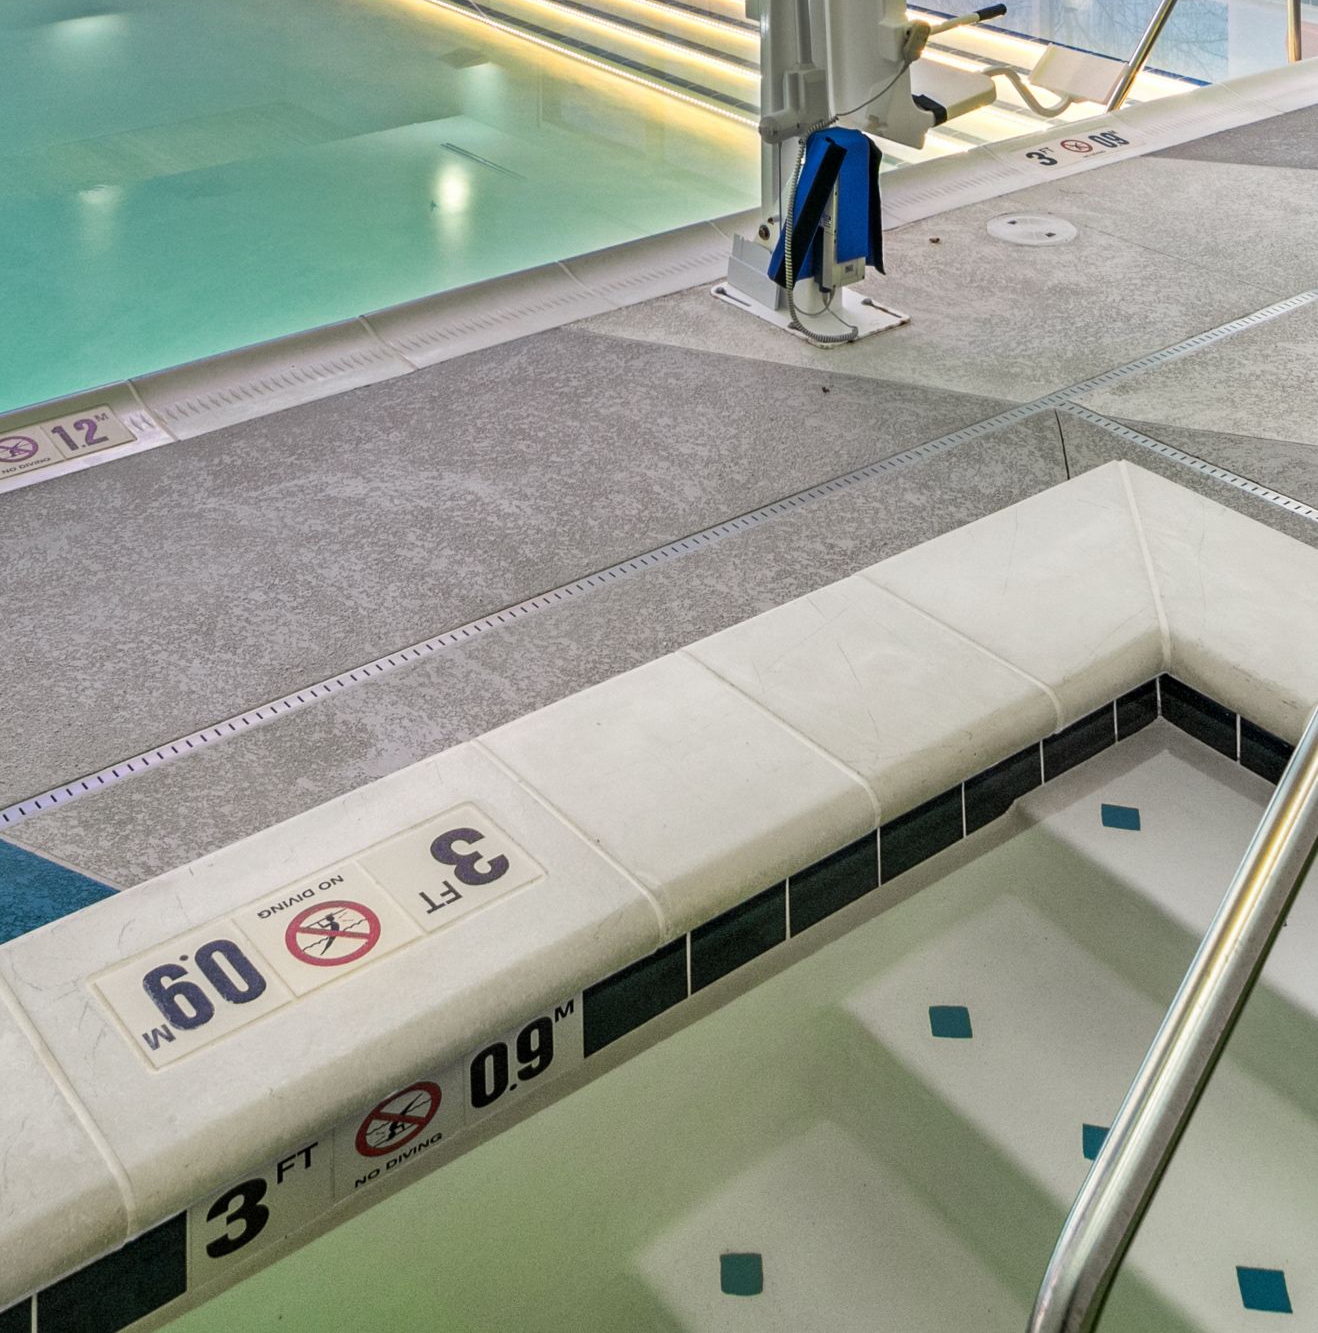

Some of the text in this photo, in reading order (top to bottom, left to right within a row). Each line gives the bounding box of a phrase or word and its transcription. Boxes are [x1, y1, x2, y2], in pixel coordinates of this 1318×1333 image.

[1026, 147, 1058, 166] 3 FT
[94, 413, 109, 422] M
[257, 874, 345, 920] NO DIVING
[418, 827, 510, 915] 3 FT
[141, 938, 267, 1051] 0.9 M
[469, 999, 575, 1109] 0.9 M
[354, 1132, 443, 1188] NO DIVING
[206, 1141, 319, 1259] 3 FT
